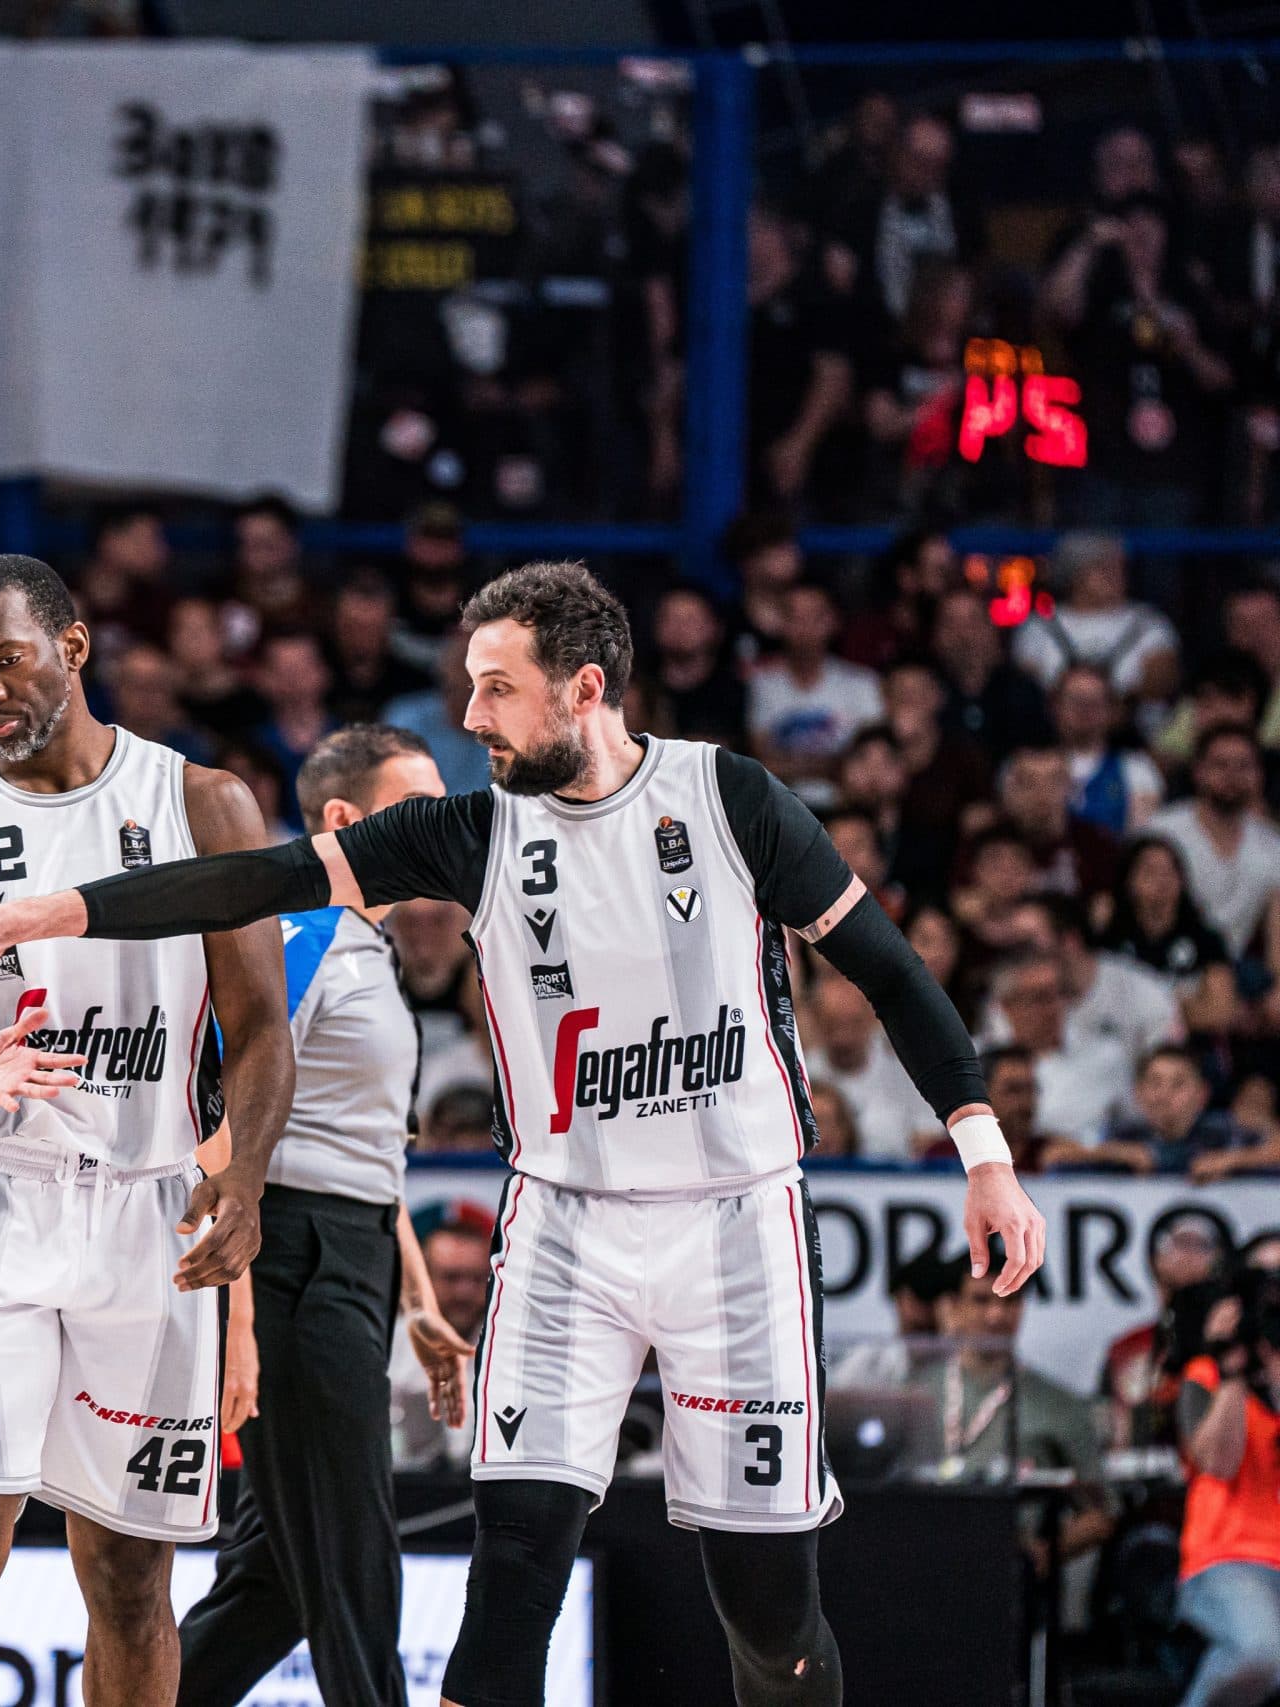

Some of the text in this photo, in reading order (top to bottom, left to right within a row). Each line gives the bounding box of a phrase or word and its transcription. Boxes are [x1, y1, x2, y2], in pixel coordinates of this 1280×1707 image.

[124, 839, 148, 849] LBA
[661, 838, 686, 850] LBA
[521, 839, 558, 896] 3
[73, 1081, 132, 1099] ANETTI
[550, 1004, 746, 1135] Segafredo
[636, 1093, 717, 1119] ZANETTI
[74, 1390, 214, 1432] PENSKECARS
[126, 1436, 206, 1496] 42
[744, 1424, 782, 1486] 3
